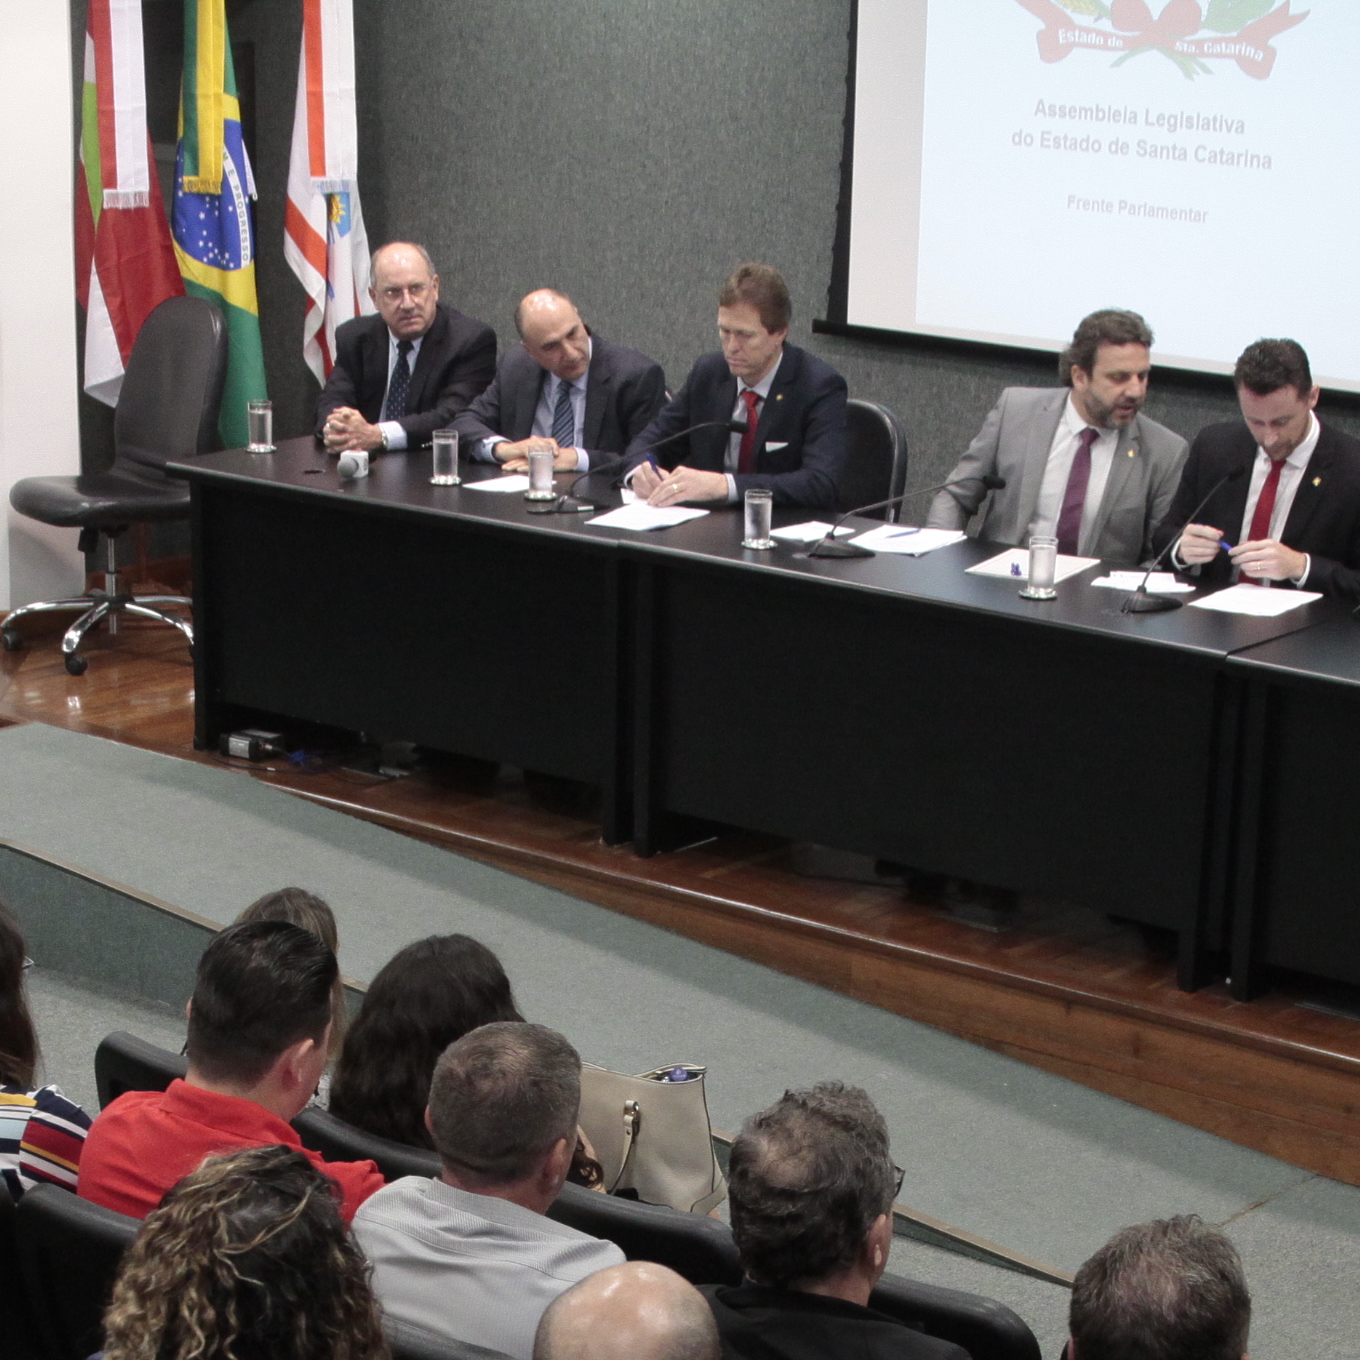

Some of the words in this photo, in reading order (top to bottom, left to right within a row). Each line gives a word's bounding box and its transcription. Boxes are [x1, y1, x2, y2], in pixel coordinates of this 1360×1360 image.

[1058, 28, 1104, 46] Estado
[1204, 42, 1264, 62] Catarina
[1034, 98, 1138, 125] Assembleia
[1144, 108, 1246, 135] Legislativa
[1011, 129, 1034, 148] do
[1040, 130, 1102, 154] Estado
[1108, 137, 1130, 156] de
[1136, 139, 1188, 162] Santa
[1194, 145, 1273, 170] Catarina
[233, 185, 249, 261] PROGRESSO
[1067, 194, 1114, 214] Frente
[1118, 199, 1209, 223] Parlamentar
